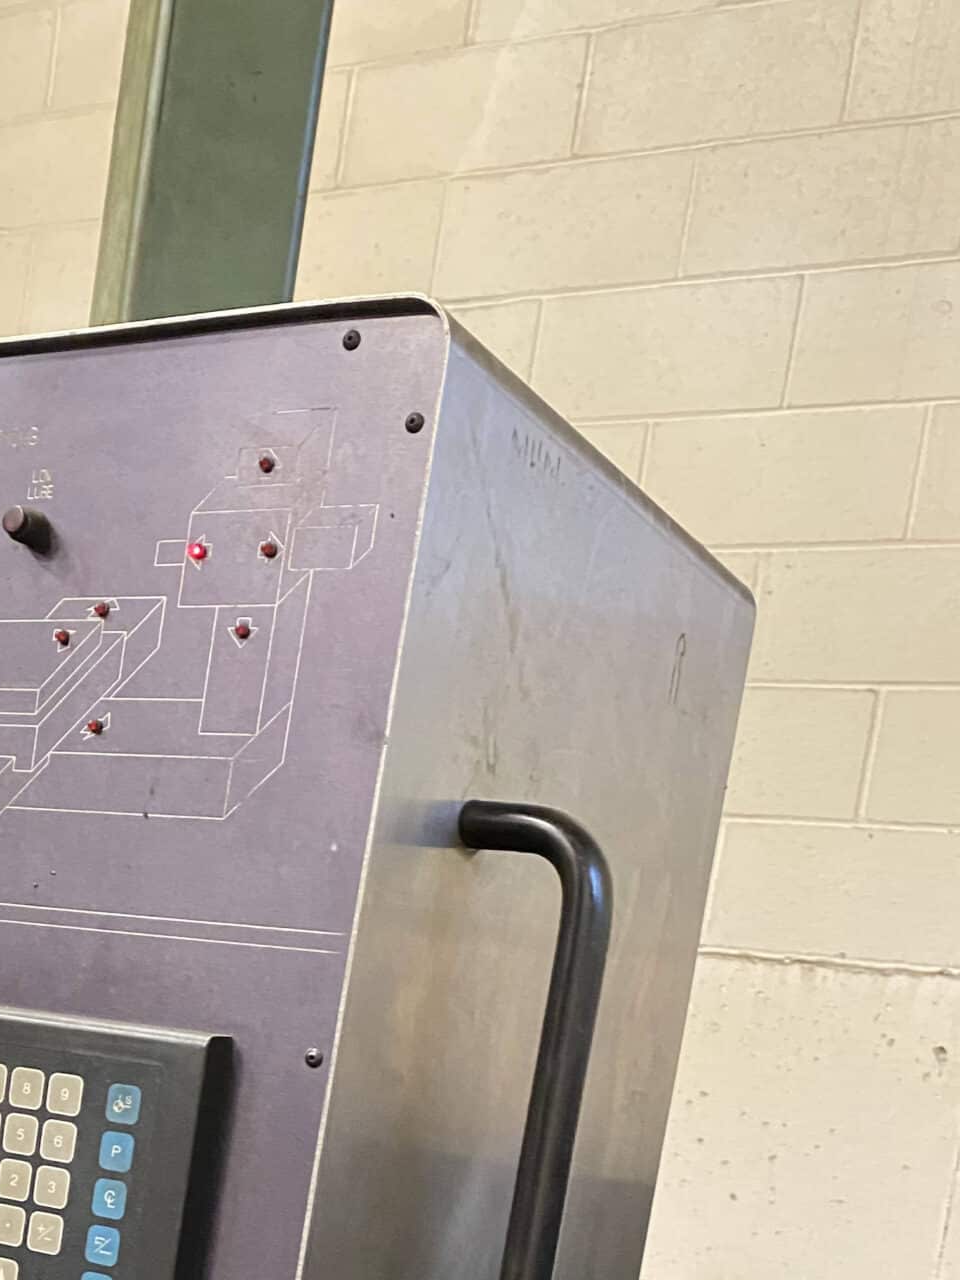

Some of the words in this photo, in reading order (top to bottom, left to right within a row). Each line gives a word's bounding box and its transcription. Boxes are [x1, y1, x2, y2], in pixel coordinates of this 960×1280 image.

[22, 1081, 31, 1095] 8
[60, 1087, 69, 1101] 9
[15, 1127, 25, 1141] 5
[53, 1135, 63, 1148] 6
[111, 1145, 122, 1158] P
[9, 1173, 18, 1187] 2
[47, 1180, 57, 1194] 3
